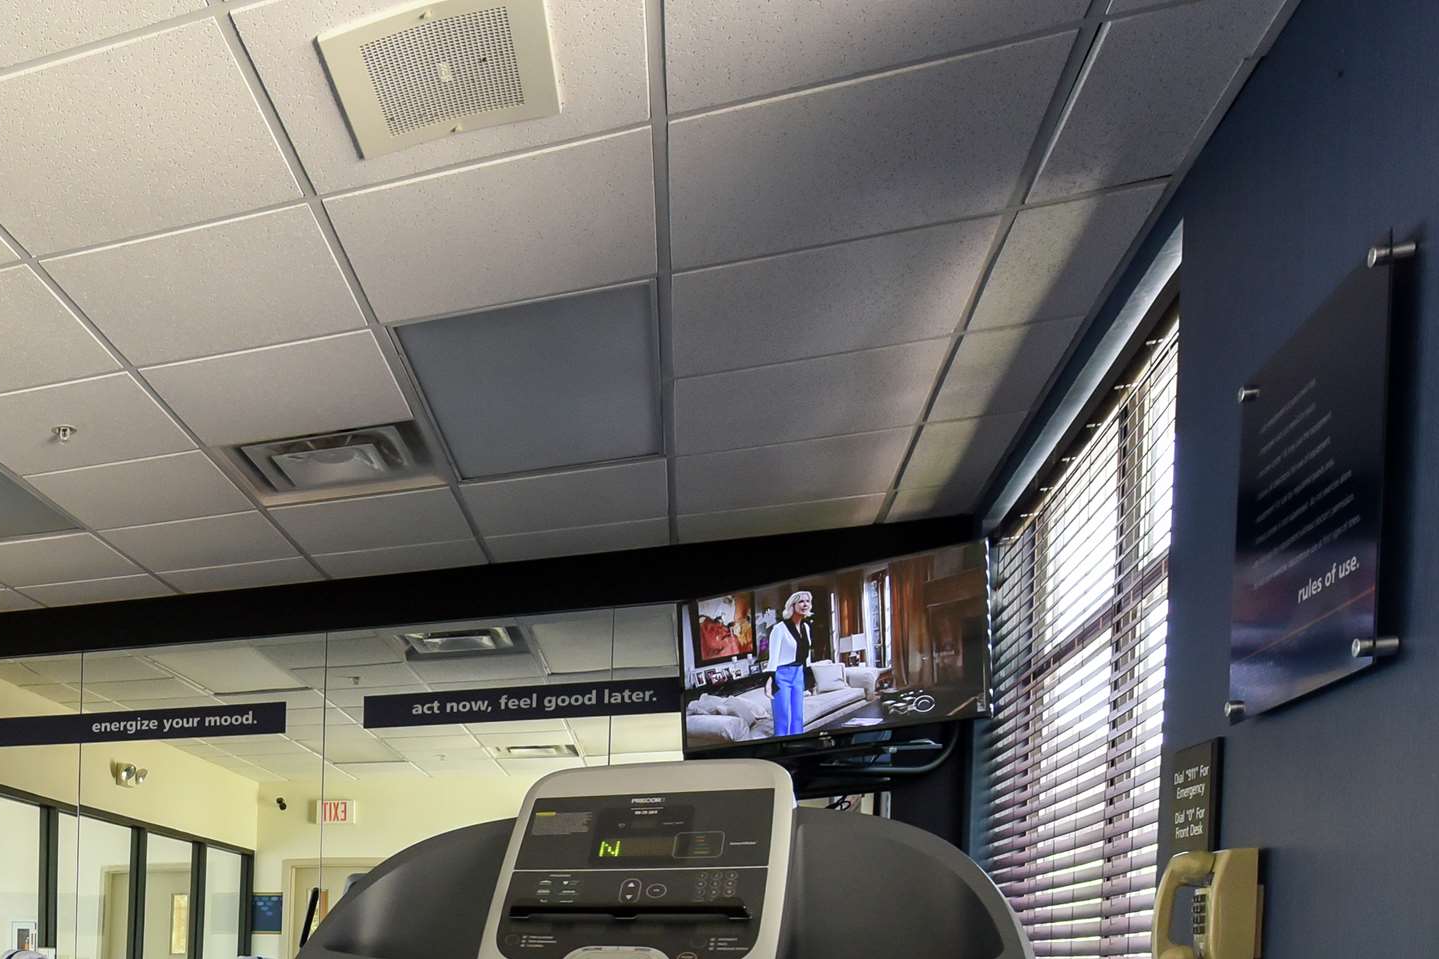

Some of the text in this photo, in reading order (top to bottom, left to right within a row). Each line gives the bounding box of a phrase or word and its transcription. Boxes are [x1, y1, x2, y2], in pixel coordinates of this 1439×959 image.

[1298, 577, 1322, 604] rules
[1325, 562, 1337, 587] of
[1339, 556, 1360, 579] use.
[411, 688, 657, 715] act now, feel good later.
[91, 711, 258, 734] energize your mood.
[1200, 764, 1210, 777] For
[1176, 783, 1206, 800] Emergency
[1196, 807, 1206, 820] For
[1175, 821, 1203, 839] Front Desk
